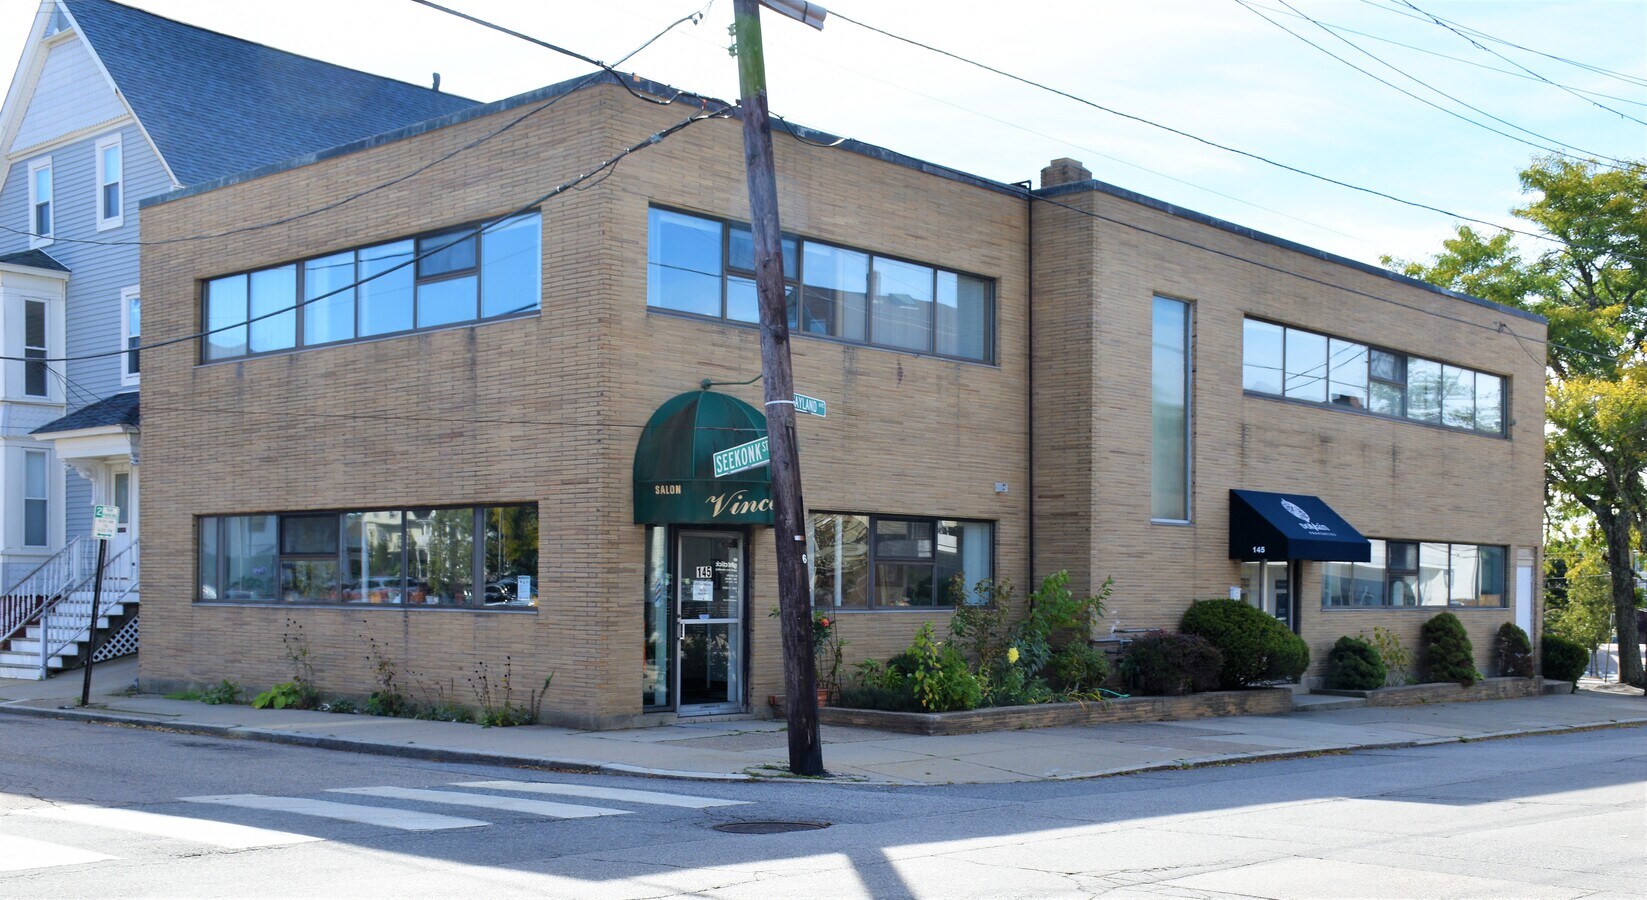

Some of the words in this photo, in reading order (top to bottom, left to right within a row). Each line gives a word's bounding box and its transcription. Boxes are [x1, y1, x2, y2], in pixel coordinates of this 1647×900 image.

[794, 395, 817, 413] AYLAND
[716, 443, 762, 473] SEEKONK
[761, 440, 769, 452] ST
[655, 485, 681, 495] SALON
[97, 507, 103, 516] 2
[802, 554, 807, 564] 6
[696, 566, 712, 578] 145
